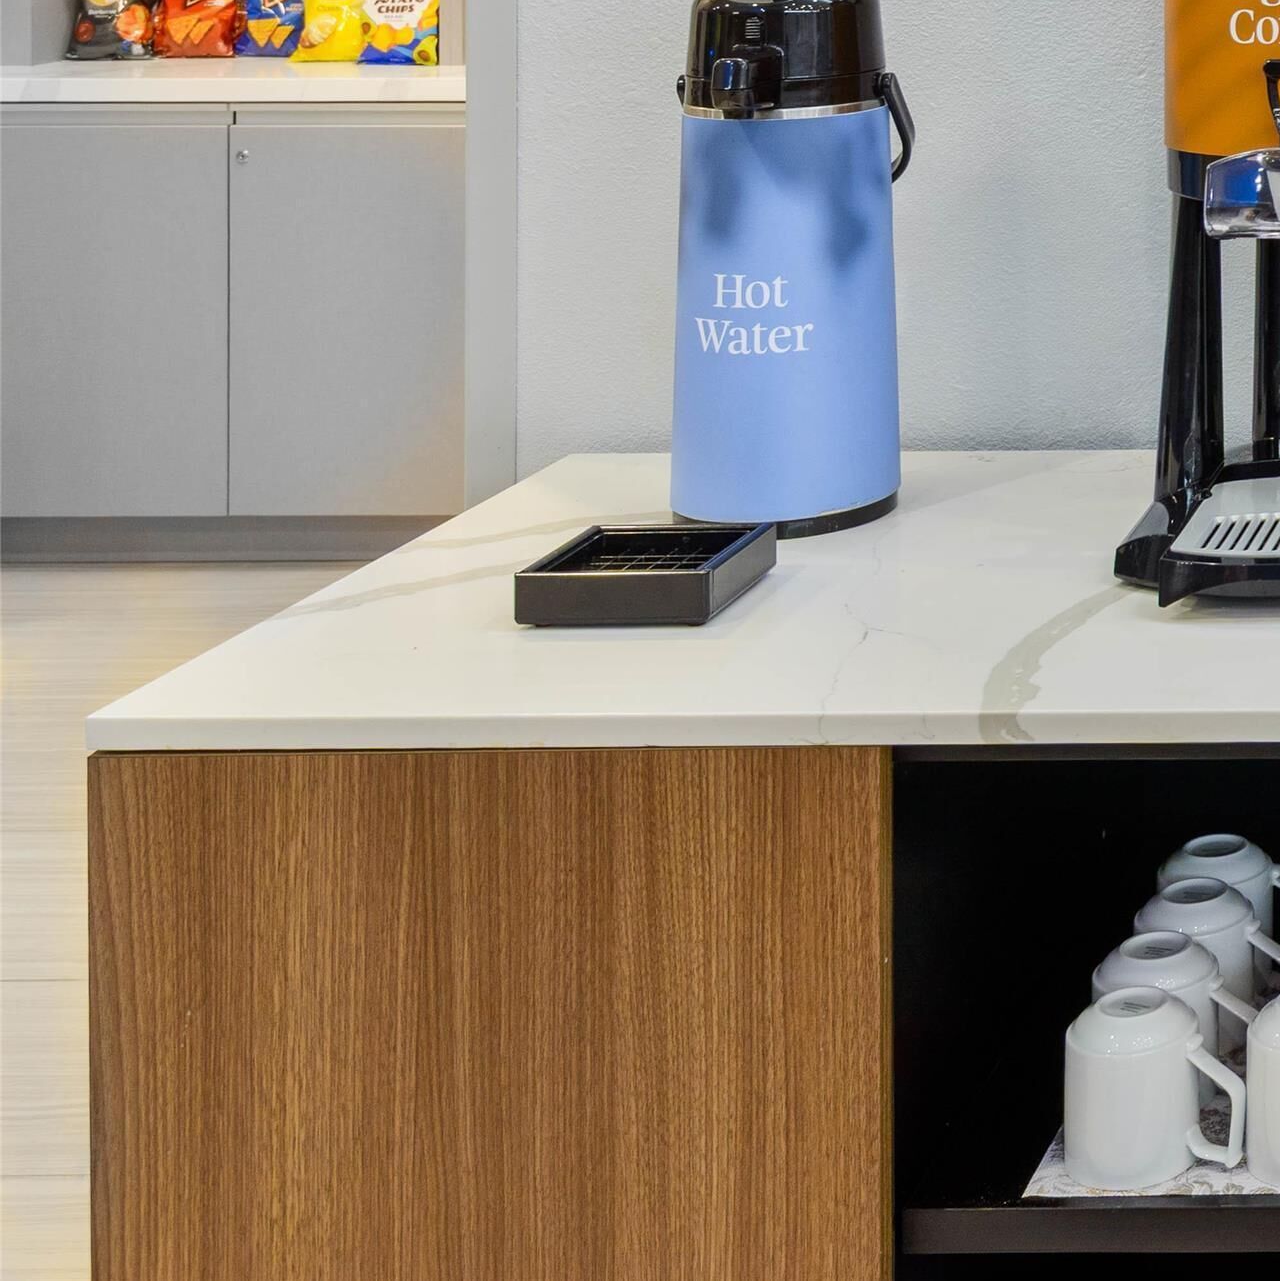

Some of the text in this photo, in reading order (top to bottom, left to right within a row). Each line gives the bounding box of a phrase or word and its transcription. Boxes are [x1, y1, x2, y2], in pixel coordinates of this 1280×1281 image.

[378, 5, 414, 14] CHIPS
[713, 274, 788, 309] Hot
[695, 317, 814, 355] Water
